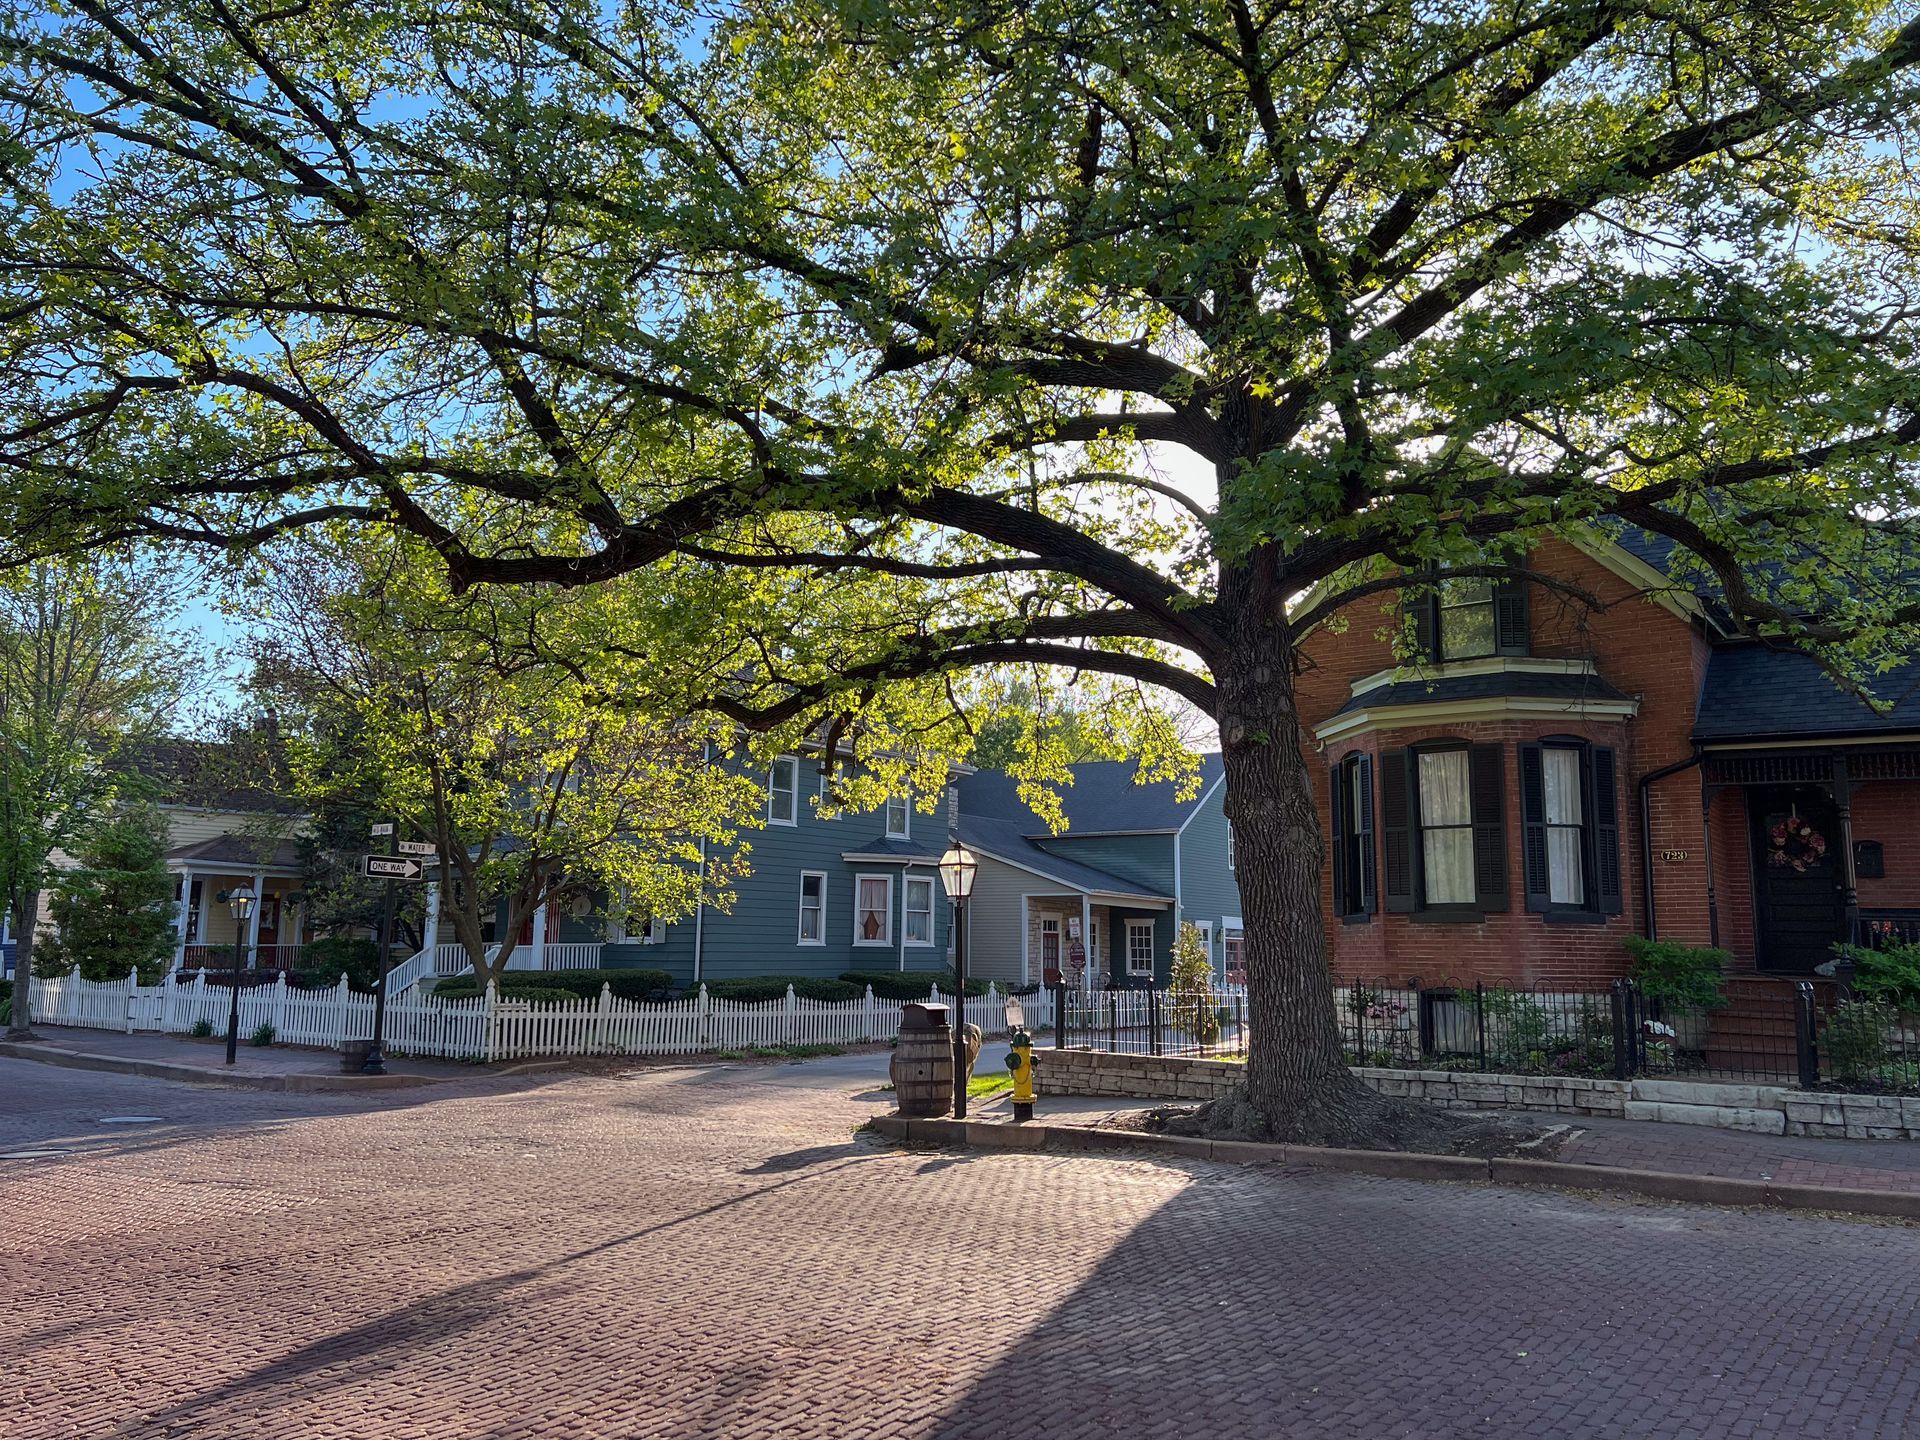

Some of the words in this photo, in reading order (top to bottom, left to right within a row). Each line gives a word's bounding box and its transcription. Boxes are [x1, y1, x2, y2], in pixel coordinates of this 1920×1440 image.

[408, 844, 425, 853] WATER
[1665, 851, 1684, 860] 723
[372, 862, 388, 870] ONE
[390, 863, 406, 872] WAY
